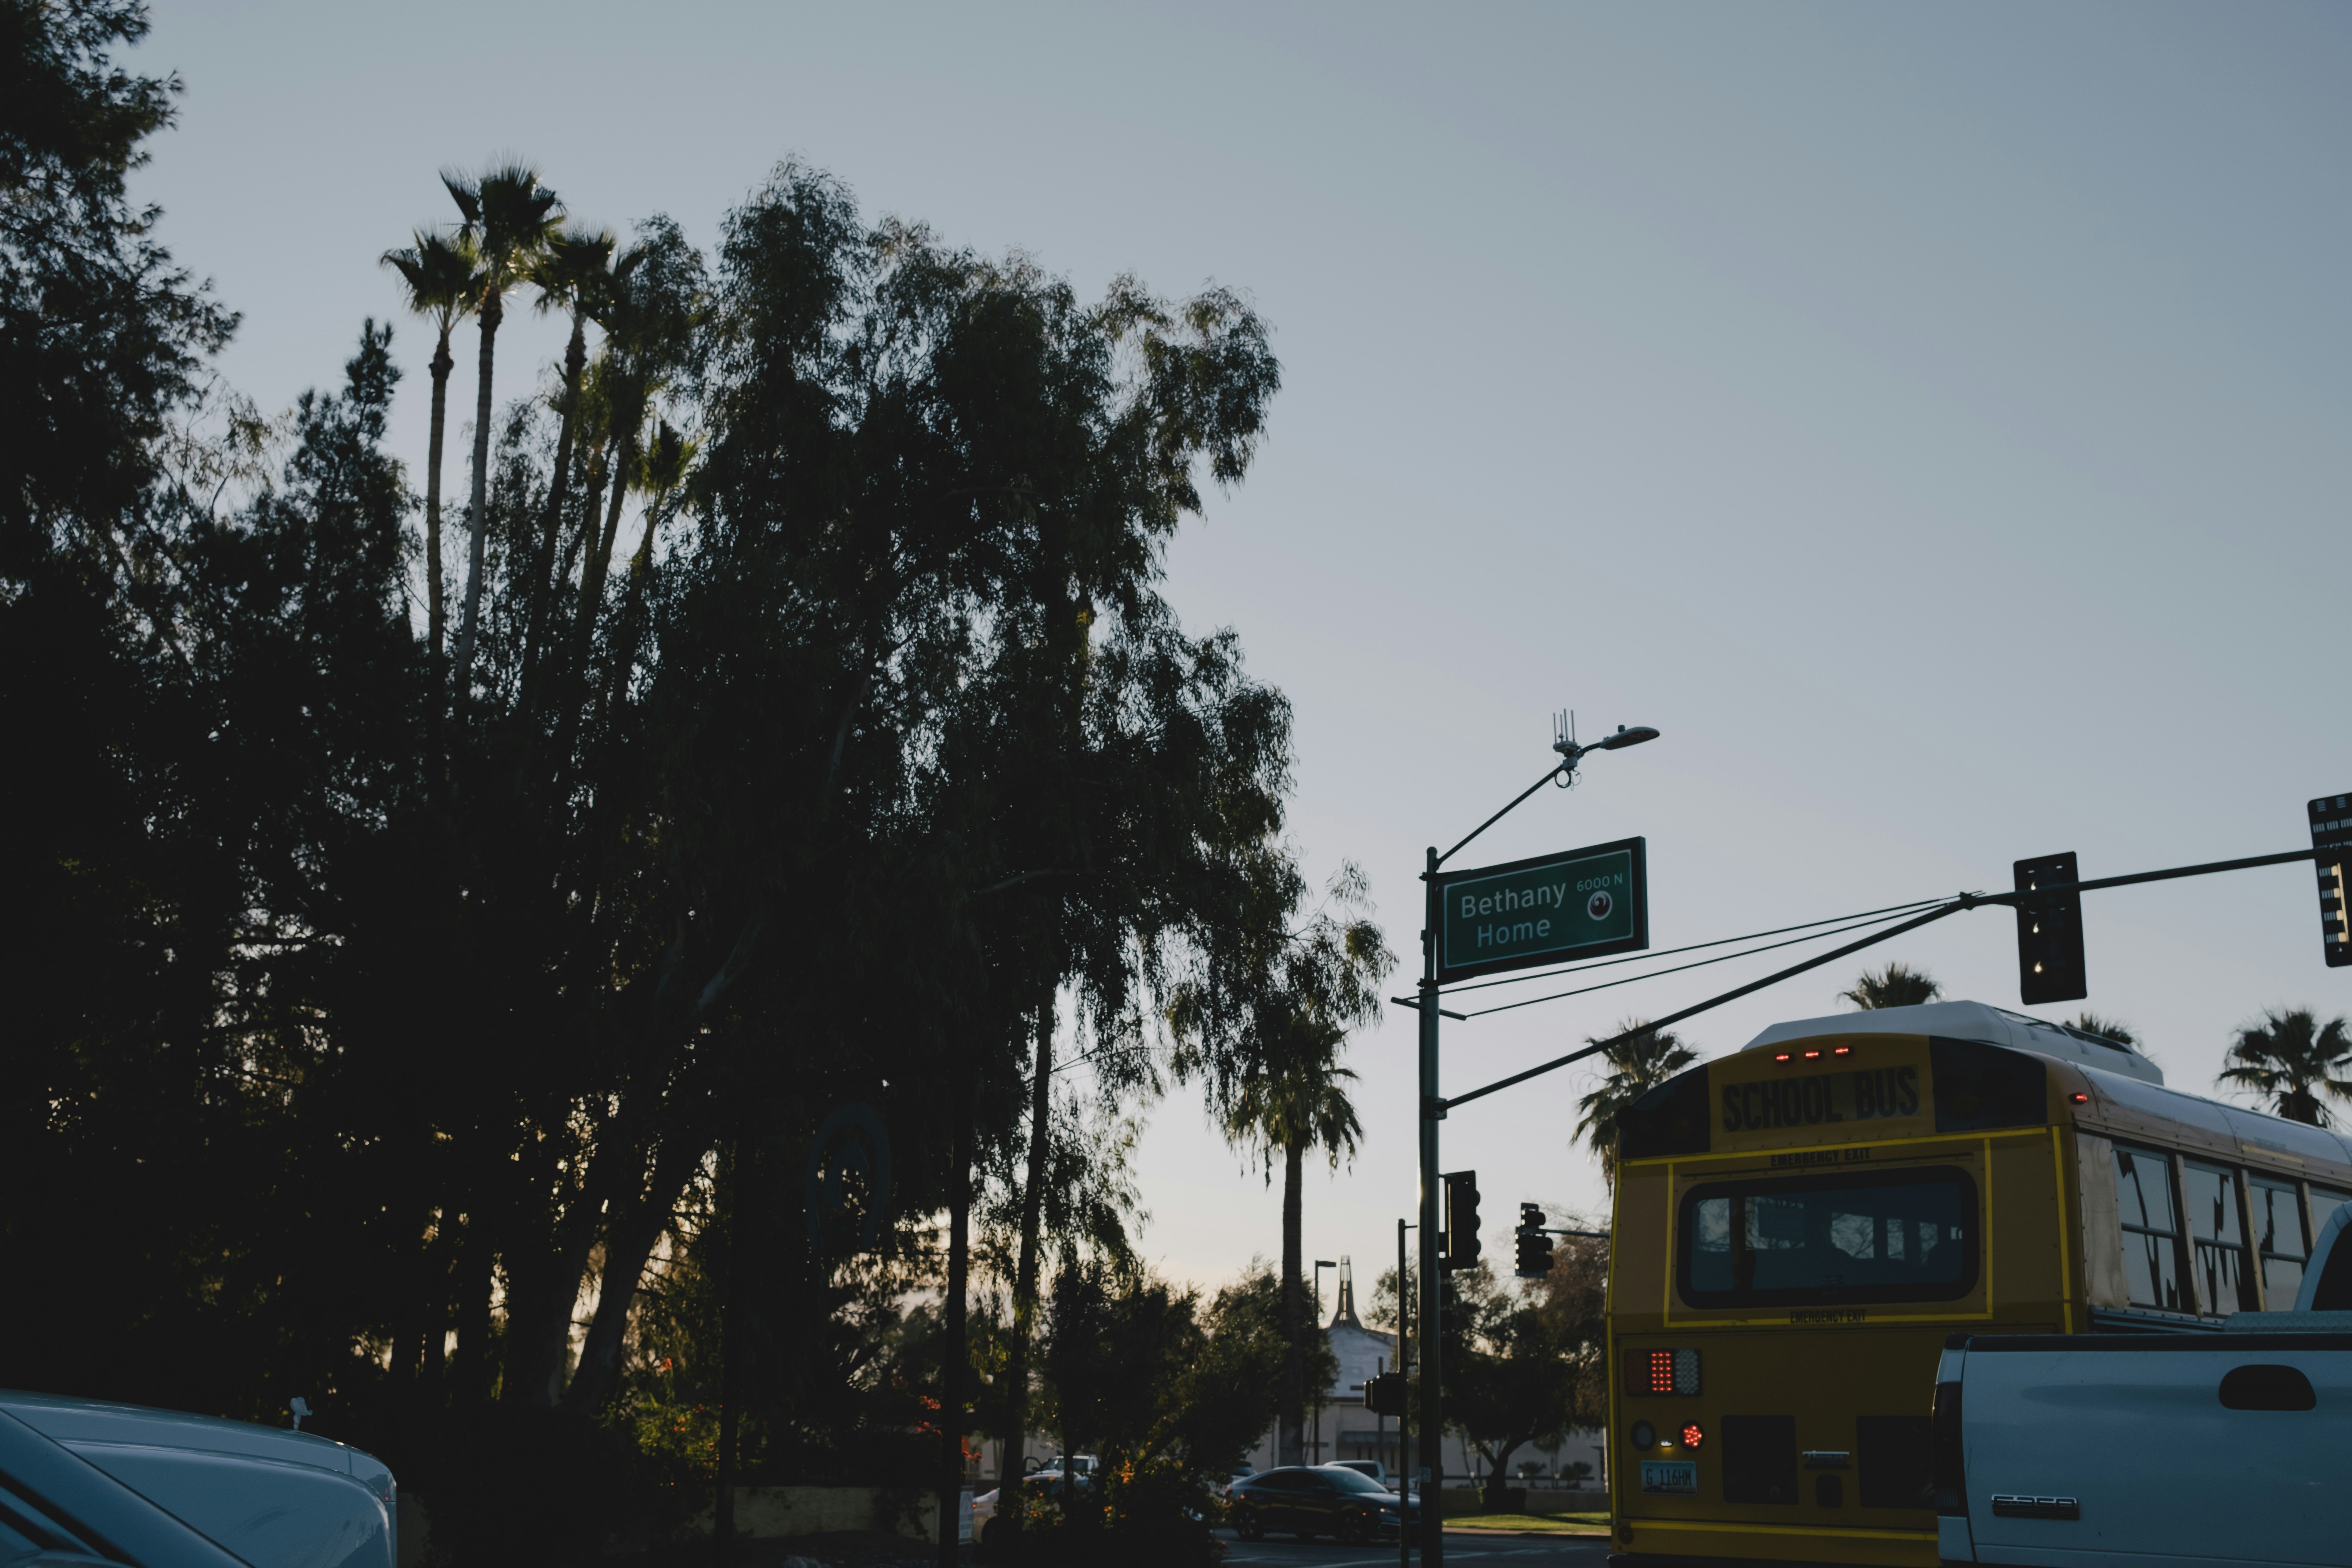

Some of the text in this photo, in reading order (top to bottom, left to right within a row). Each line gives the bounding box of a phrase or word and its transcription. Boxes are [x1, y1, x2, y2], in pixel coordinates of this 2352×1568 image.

[1577, 873, 1623, 891] 6000 N
[1462, 883, 1566, 919] Bethany
[1478, 919, 1550, 948] Home
[1723, 1066, 1918, 1132] SCHOOL BUS
[1771, 1147, 1871, 1167] EMERGENCY EXIT
[1790, 1309, 1866, 1323] EMERGENCY EXIT
